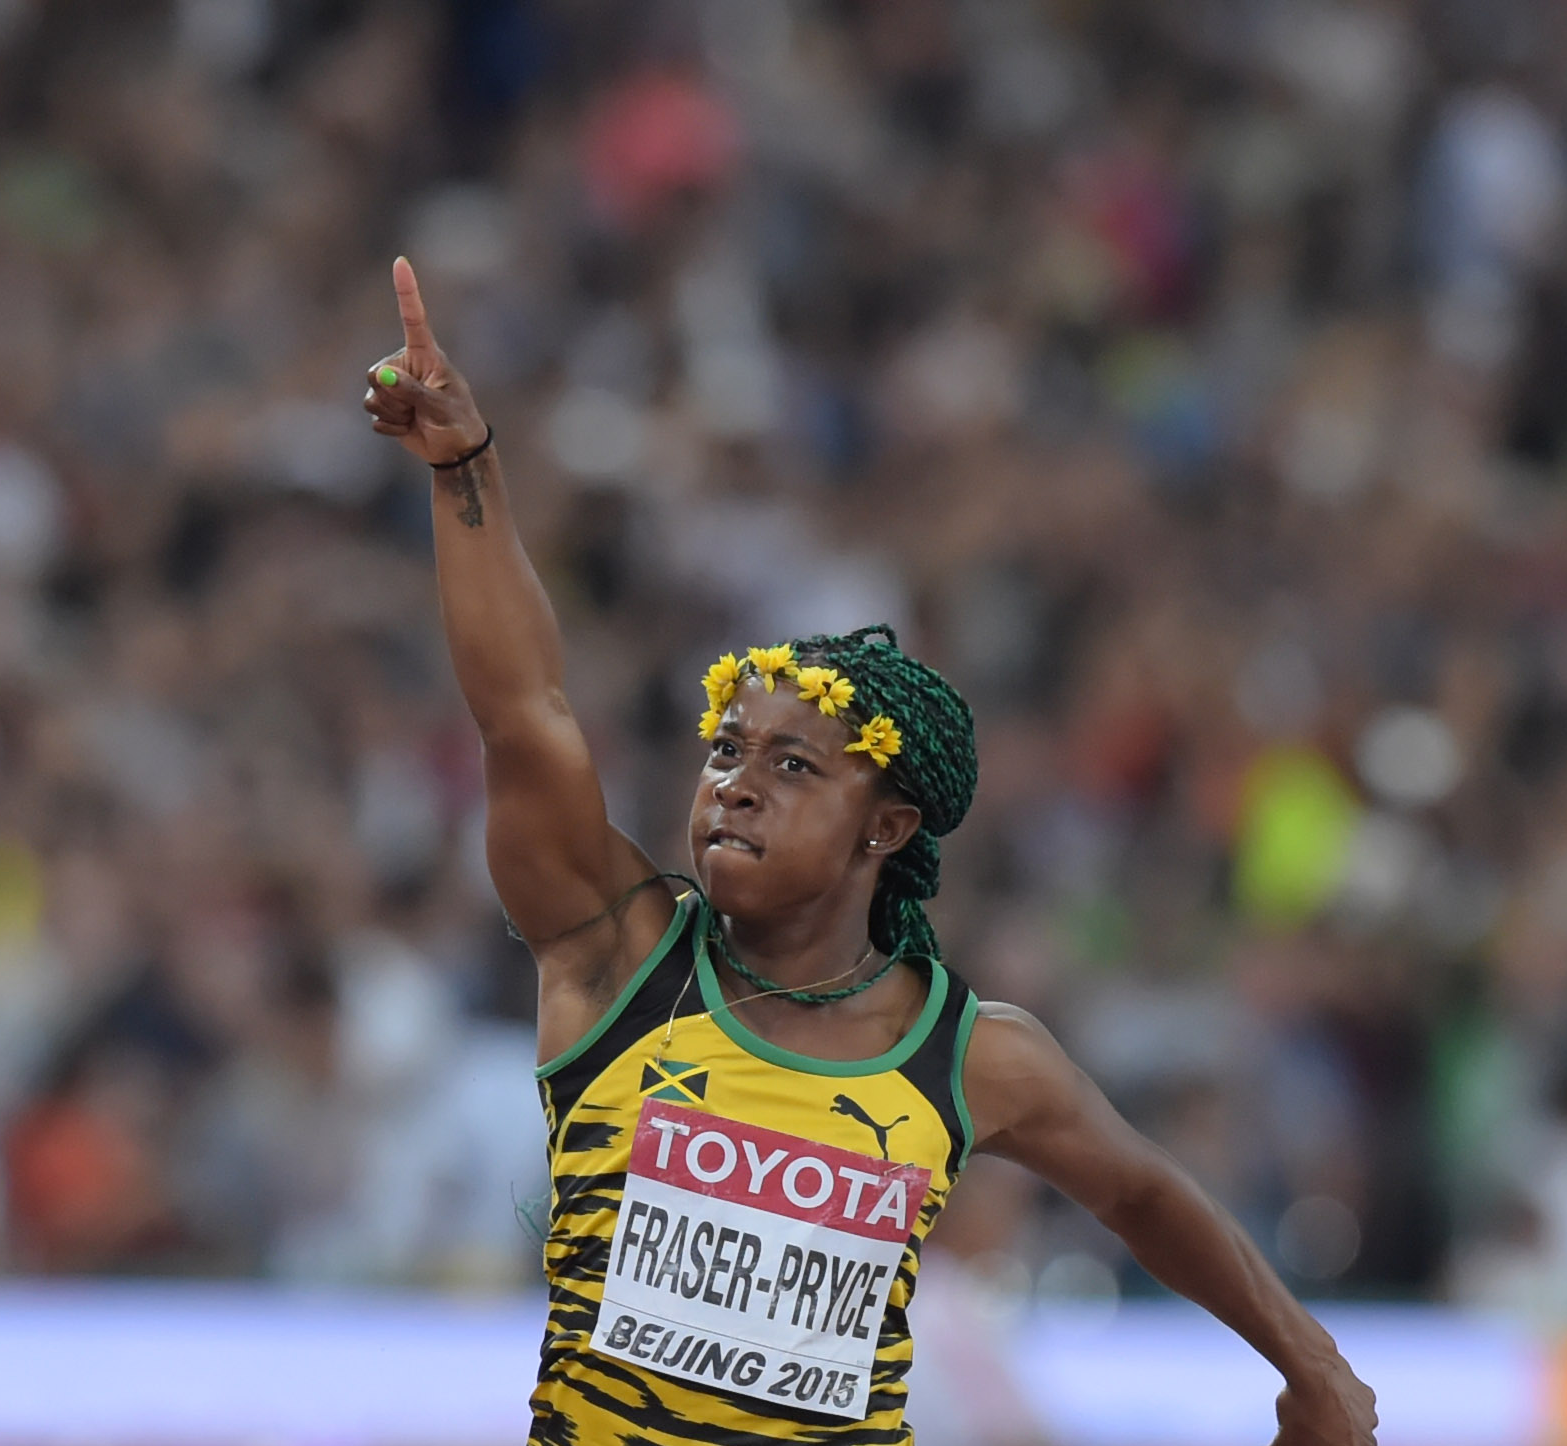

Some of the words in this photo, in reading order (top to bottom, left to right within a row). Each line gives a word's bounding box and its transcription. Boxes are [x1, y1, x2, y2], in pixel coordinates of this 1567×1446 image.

[650, 1116, 906, 1230] TOYOTA
[615, 1201, 887, 1340] FRASER-PRYCE
[604, 1315, 765, 1386] BEIJING
[767, 1362, 859, 1408] 2015
